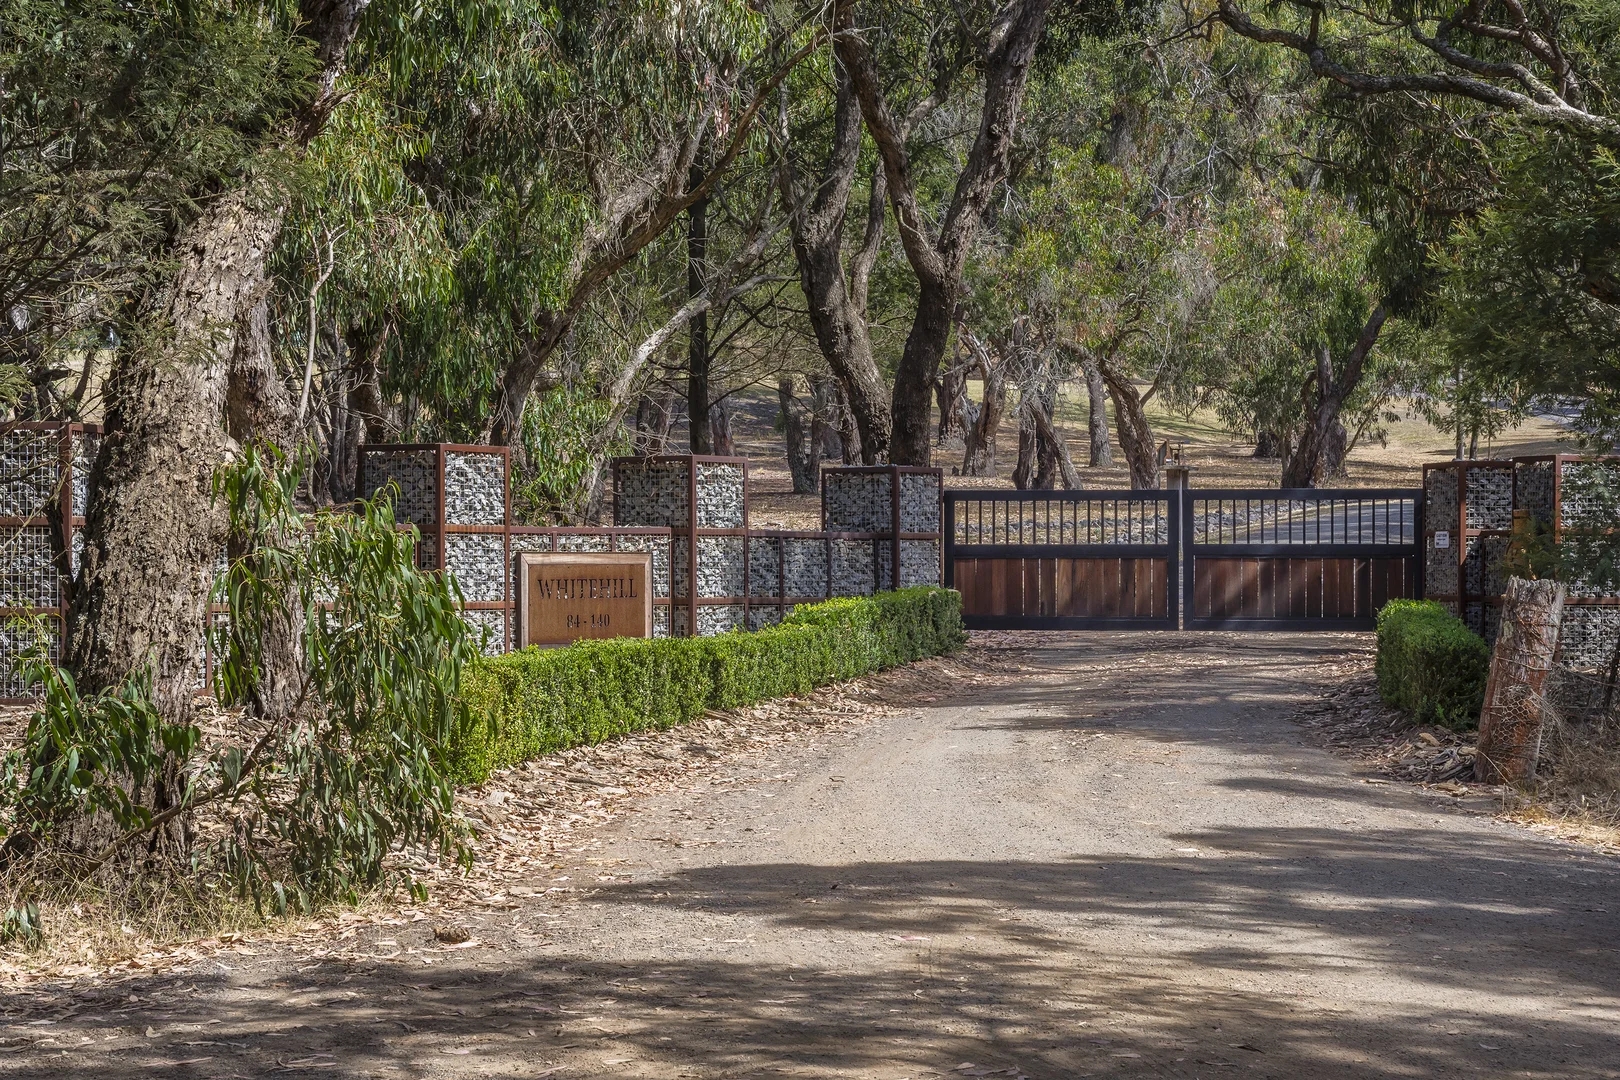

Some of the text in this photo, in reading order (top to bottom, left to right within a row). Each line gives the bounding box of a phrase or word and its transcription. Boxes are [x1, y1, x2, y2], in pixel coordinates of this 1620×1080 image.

[538, 578, 637, 599] WHITEHILL
[567, 614, 580, 628] 84
[591, 613, 610, 628] 140
